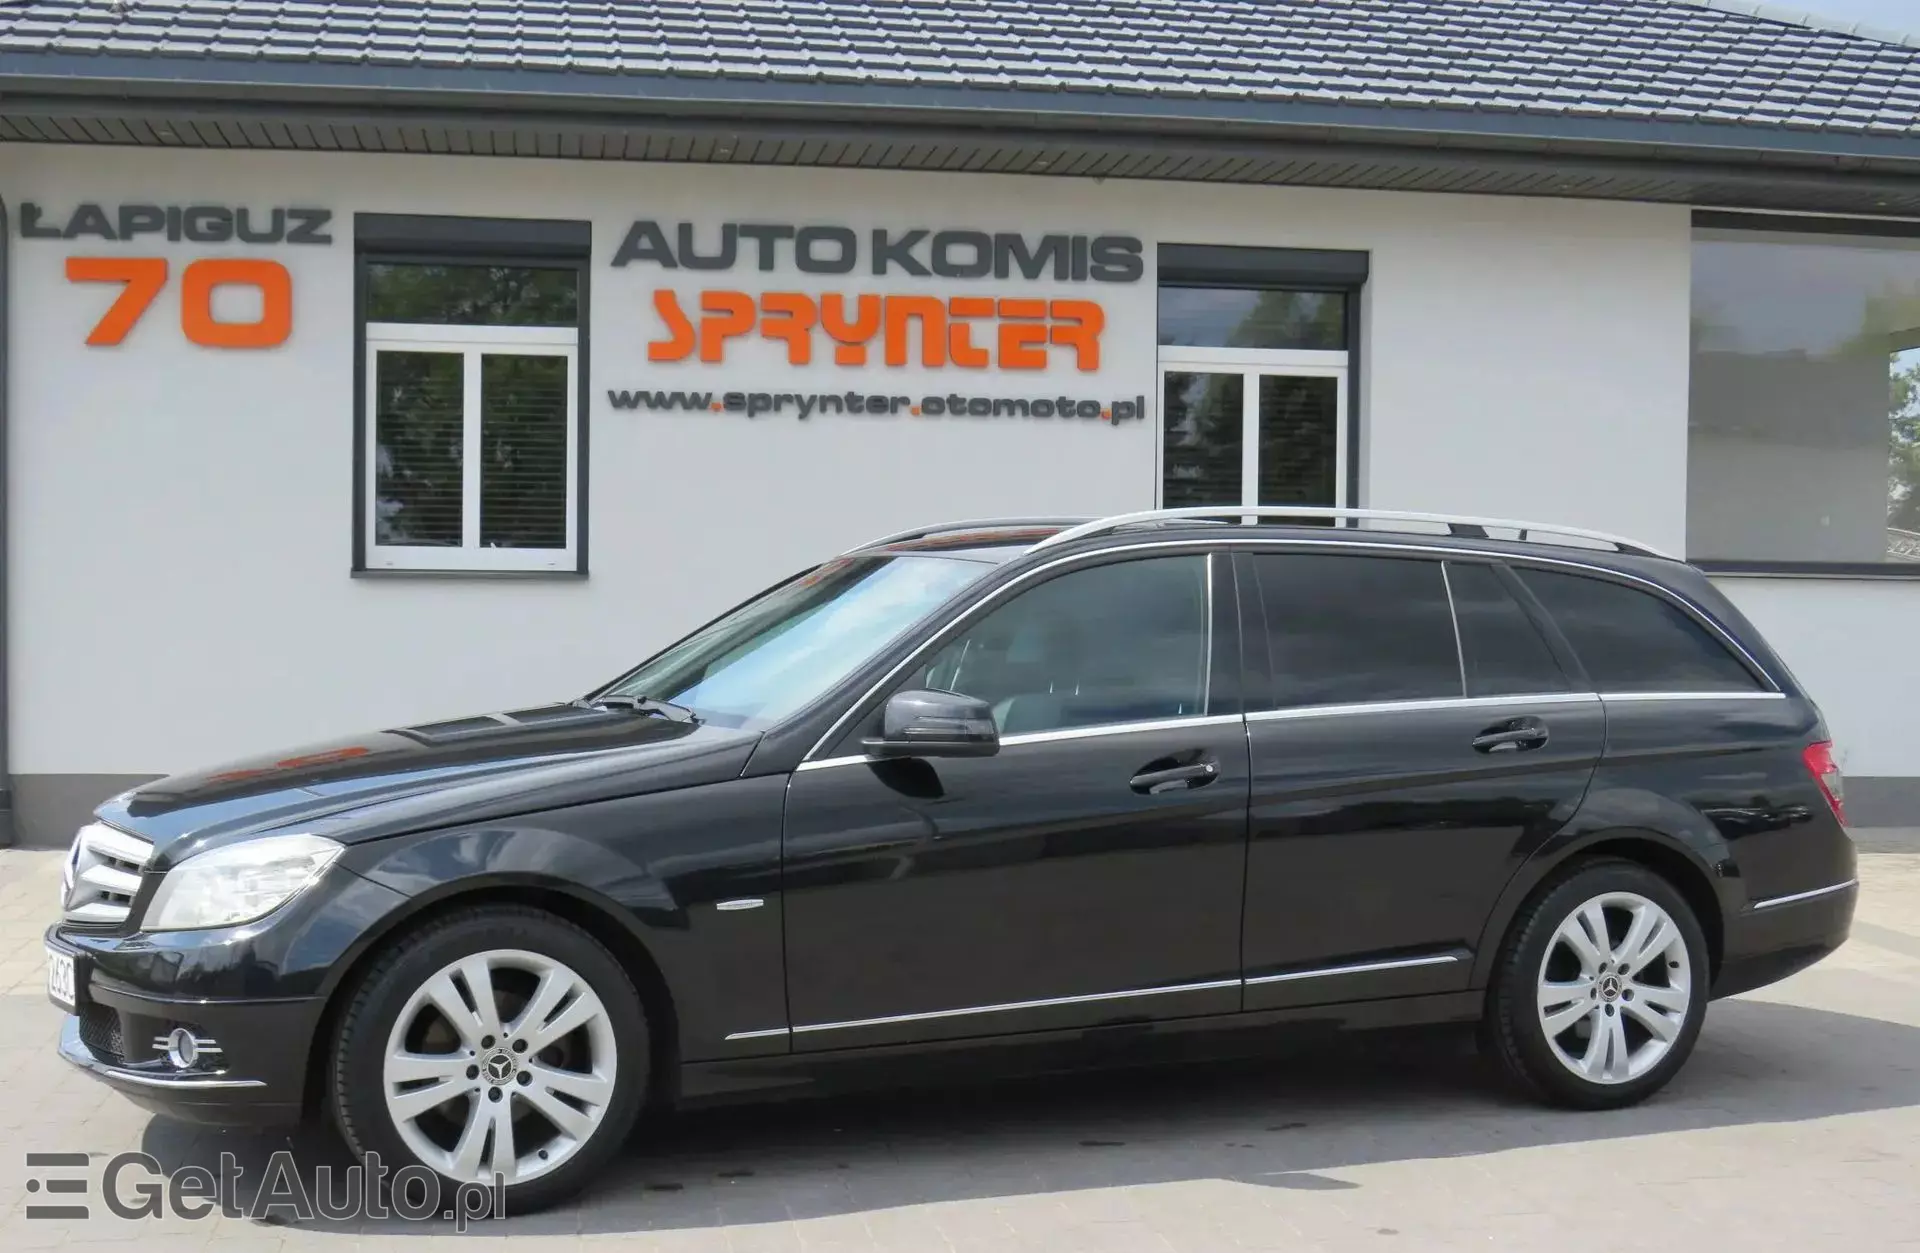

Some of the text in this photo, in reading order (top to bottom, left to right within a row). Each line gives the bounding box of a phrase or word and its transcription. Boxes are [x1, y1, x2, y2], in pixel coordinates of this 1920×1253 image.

[21, 202, 332, 245] ŁAPIGUZ
[611, 220, 1143, 283] AUTO KOMIS
[65, 256, 293, 347] 70
[647, 289, 1105, 371] SPRYNTER
[607, 390, 1146, 426] www.sprynter.otomoto.pl
